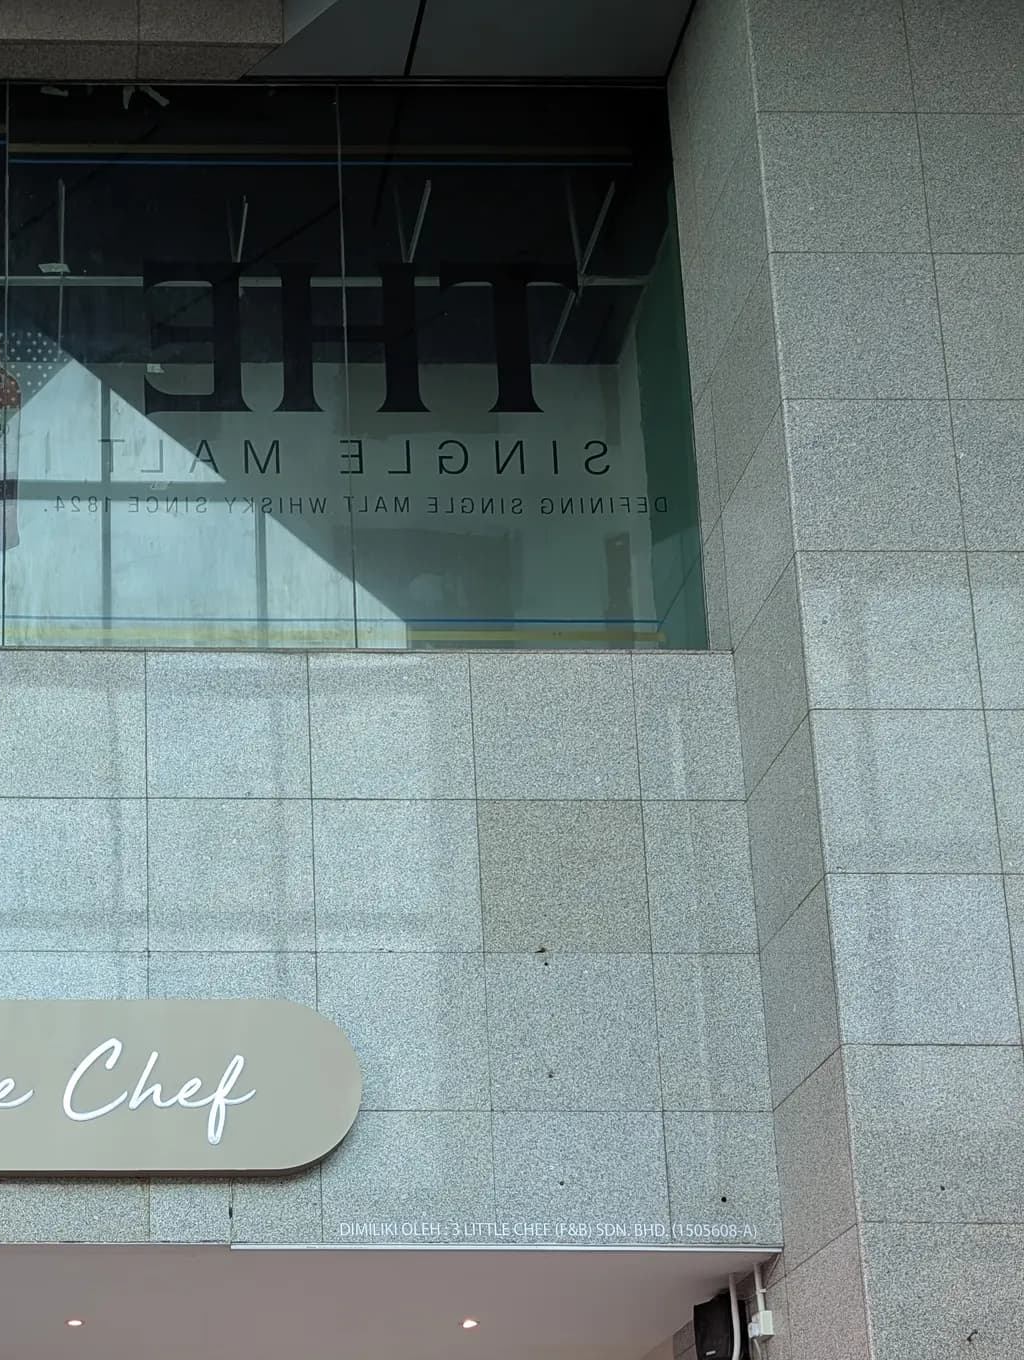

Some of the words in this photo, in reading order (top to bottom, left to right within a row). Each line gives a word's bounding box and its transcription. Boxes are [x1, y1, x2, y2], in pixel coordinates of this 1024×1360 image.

[62, 1037, 257, 1145] Chef
[339, 1222, 398, 1237] DIMILIKI
[401, 1222, 441, 1237] OLEH
[451, 1222, 462, 1237] 3
[463, 1222, 510, 1237] LITTLE
[512, 1222, 551, 1237] CHEF
[555, 1222, 593, 1239] (F&B)
[596, 1223, 631, 1237] SDN.
[634, 1223, 669, 1238] BHD.
[672, 1223, 758, 1239] (1505608-A)
